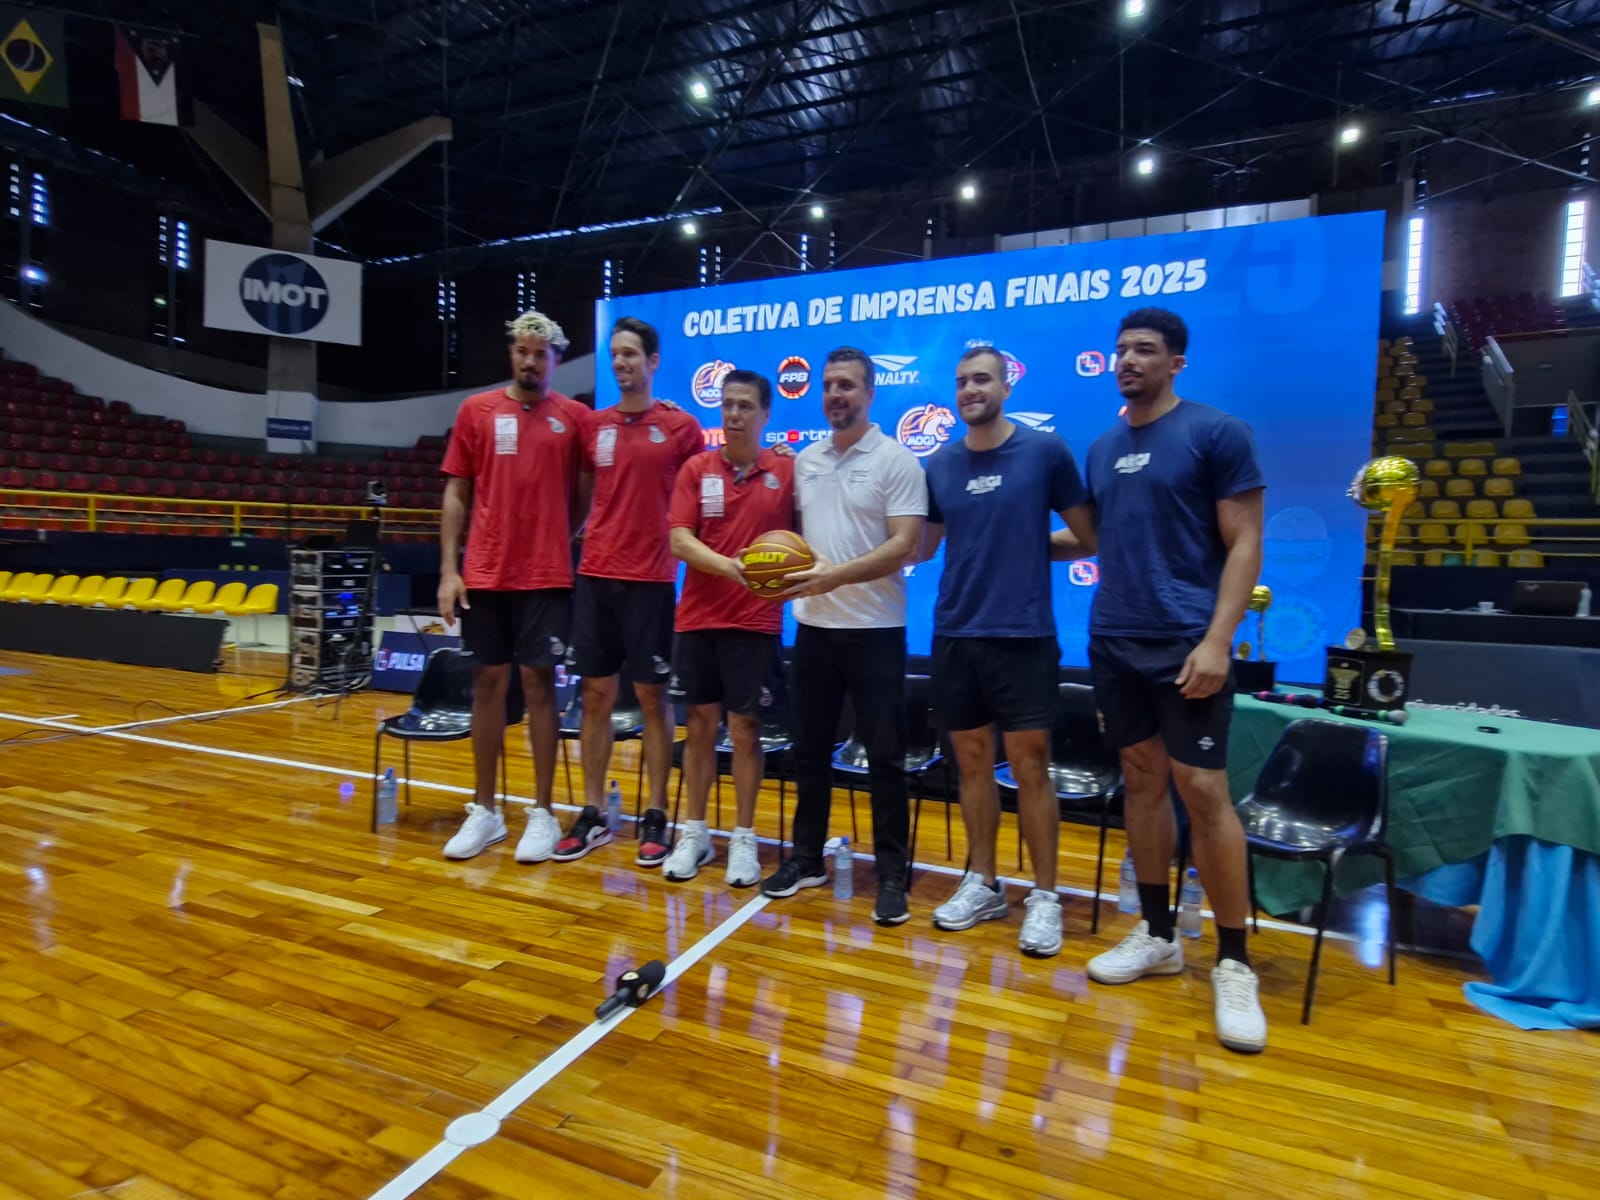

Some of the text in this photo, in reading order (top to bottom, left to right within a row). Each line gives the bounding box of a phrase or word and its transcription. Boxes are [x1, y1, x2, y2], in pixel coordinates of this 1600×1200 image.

[243, 277, 327, 310] IMOT
[684, 258, 1208, 337] COLETIVA DE IMPRENSA FINAIS 2025
[779, 372, 809, 383] FPB
[874, 371, 920, 386] NALTY
[700, 388, 723, 398] MOG
[907, 435, 936, 446] MOGI
